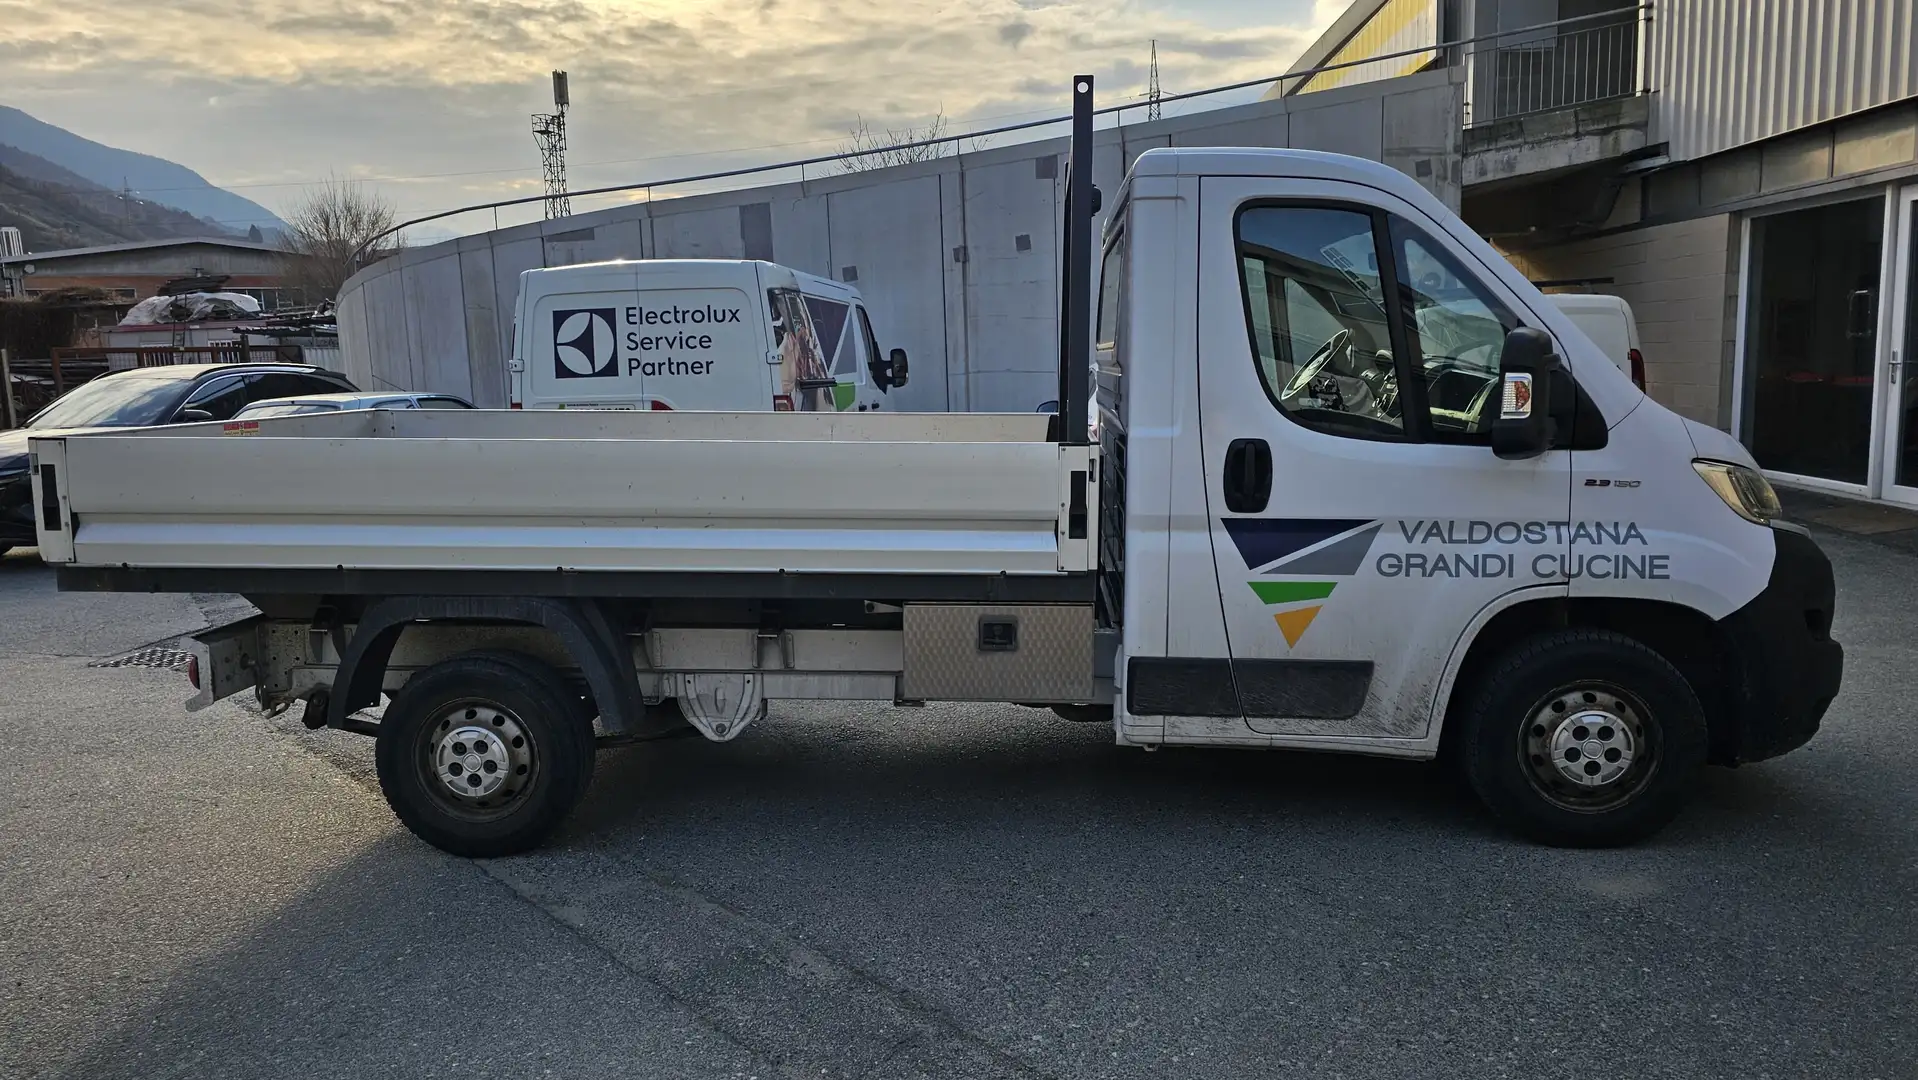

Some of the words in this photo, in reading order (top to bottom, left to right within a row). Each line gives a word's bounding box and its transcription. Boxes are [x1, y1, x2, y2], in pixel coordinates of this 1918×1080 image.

[625, 304, 741, 326] Electrolux
[626, 330, 713, 351] Service
[627, 356, 715, 377] Partner
[1397, 520, 1649, 546] VALDOSTANA
[1375, 552, 1515, 579] GRANDI
[1531, 553, 1671, 580] CUCINE
